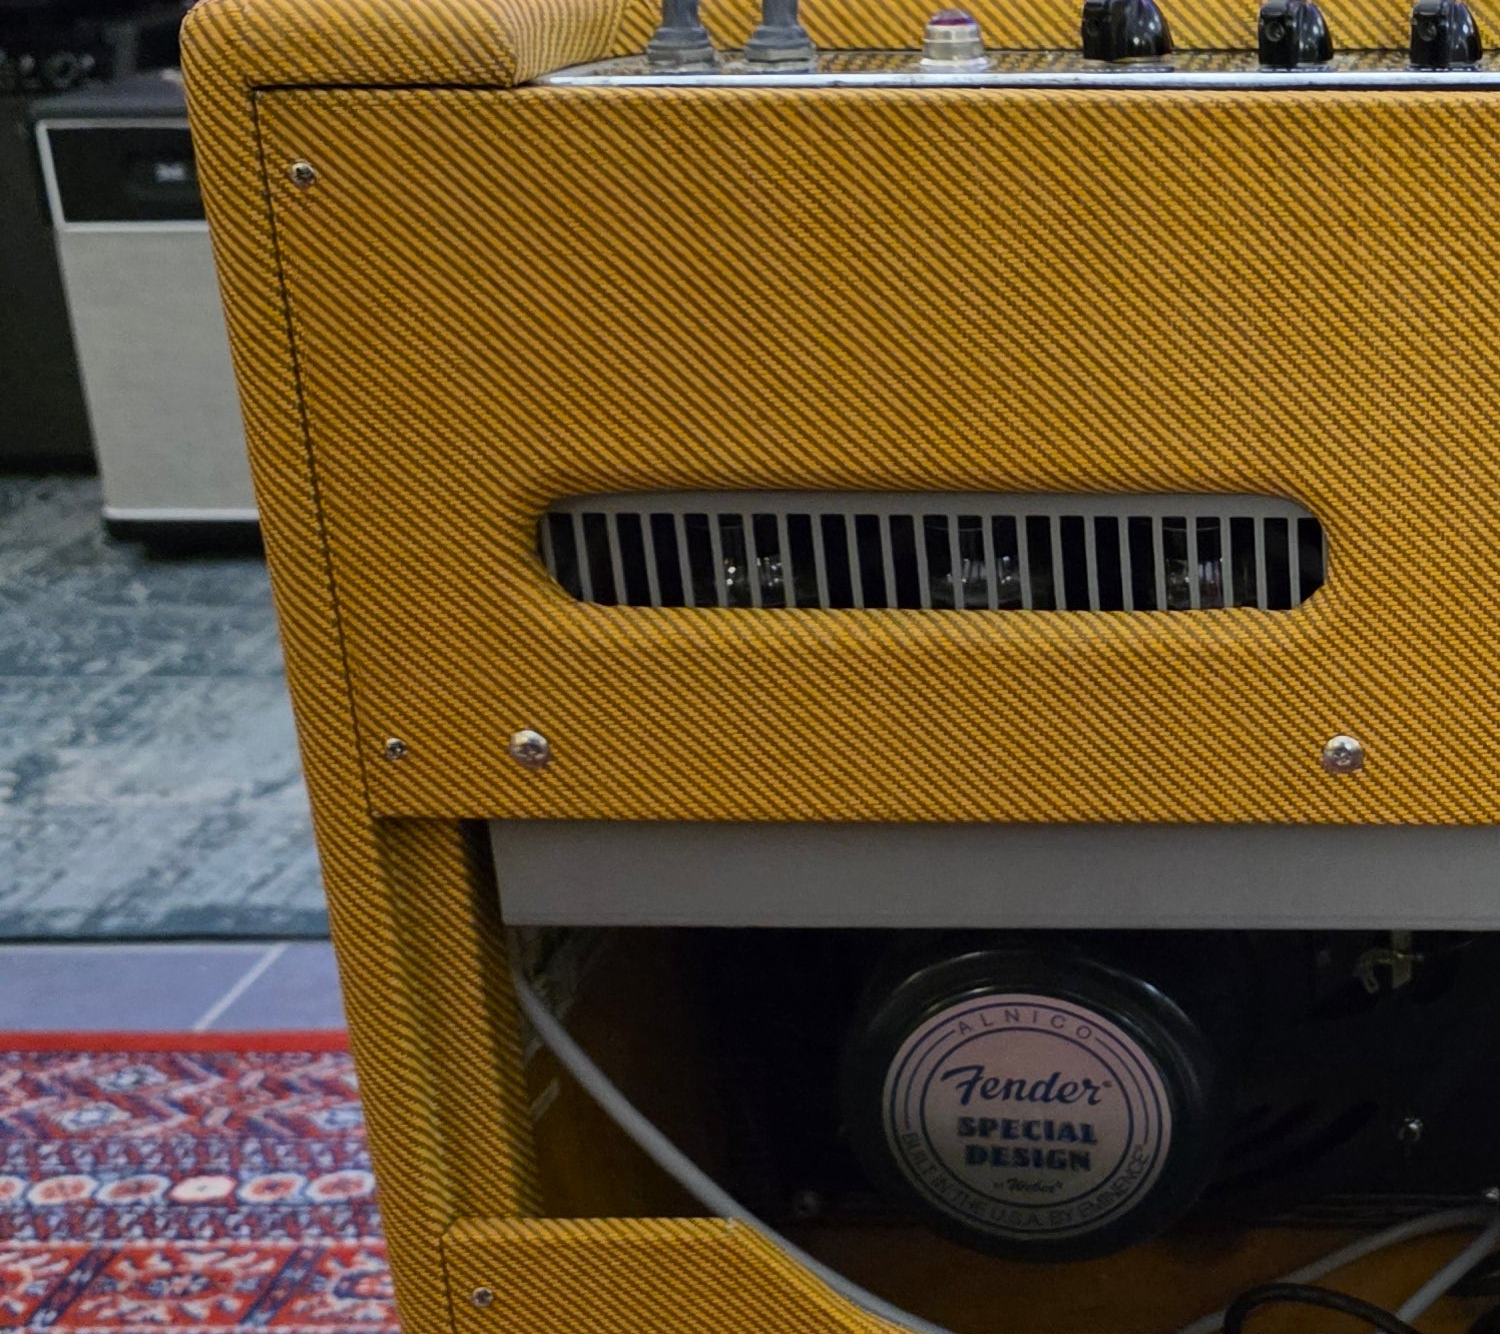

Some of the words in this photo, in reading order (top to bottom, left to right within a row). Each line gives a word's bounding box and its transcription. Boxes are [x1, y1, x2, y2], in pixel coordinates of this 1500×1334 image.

[956, 1007, 1094, 1041] ALNICO
[940, 1065, 1104, 1107] Fender
[957, 1117, 1098, 1145] SPECIAL
[965, 1144, 1092, 1173] DESIGN
[950, 1189, 989, 1220] THE
